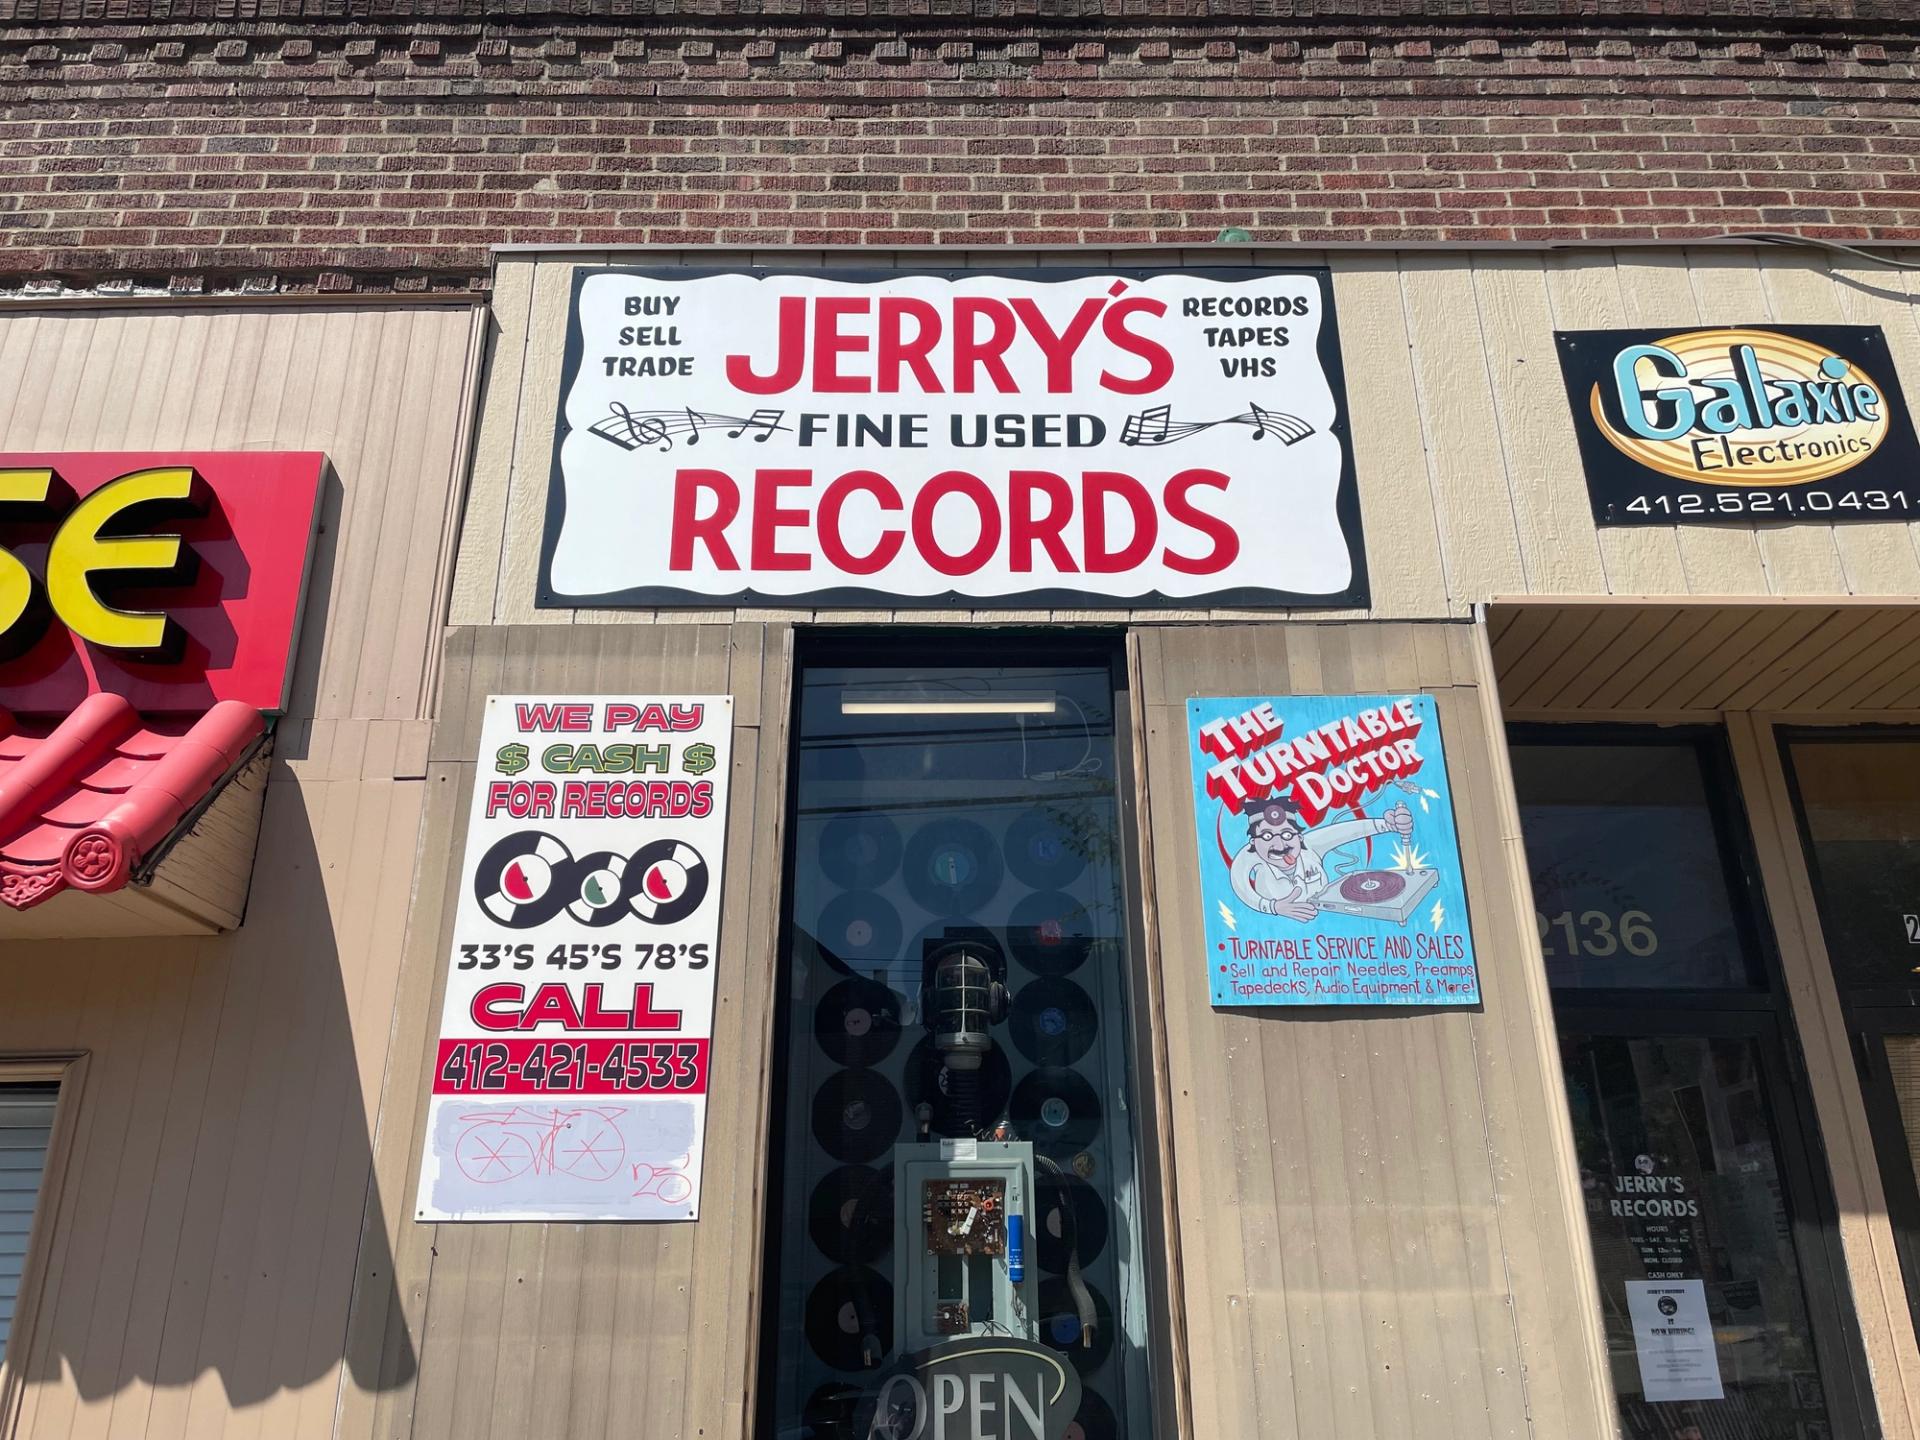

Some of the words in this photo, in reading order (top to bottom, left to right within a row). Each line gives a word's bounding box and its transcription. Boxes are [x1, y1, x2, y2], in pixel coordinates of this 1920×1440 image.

[624, 295, 680, 316] BUY
[1183, 295, 1310, 317] RECORDS
[618, 325, 682, 347] SELL
[725, 279, 1175, 396] JERRY'S
[1203, 326, 1290, 348] TAPES
[602, 355, 695, 377] TRADE
[1221, 357, 1278, 379] VHS
[1611, 343, 1880, 442] Galaxie
[798, 413, 929, 449] FINE
[951, 412, 1108, 449] USED
[1690, 434, 1873, 472] Electronics
[1625, 489, 1910, 516] 412.521.0431
[668, 467, 1241, 576] RECORDS
[515, 703, 594, 733] WE
[603, 703, 705, 733] PAY
[1200, 701, 1285, 757] THE
[495, 743, 530, 776] $
[541, 743, 671, 774] CASH
[682, 743, 717, 776] $
[1207, 699, 1424, 801] TURNTABLE
[1295, 738, 1425, 812] DOCTOR
[485, 780, 557, 819] FOR
[560, 780, 714, 819] RECORDS
[457, 944, 535, 971] 33'S
[546, 944, 622, 971] 45'S
[634, 944, 710, 970] 78'S
[1227, 936, 1313, 960] TURNTABLE
[1315, 933, 1379, 960] SERVICE
[1384, 935, 1412, 960] AND
[1416, 932, 1465, 960] SALES
[1230, 962, 1255, 978] Sell
[1262, 962, 1288, 977] and
[1292, 961, 1341, 983] Repair
[1347, 960, 1411, 979] Needles,
[1414, 960, 1475, 981] Preamps,
[1314, 978, 1350, 995] Audio
[1352, 977, 1421, 1000] Equipment
[1425, 978, 1434, 994] &
[470, 981, 683, 1031] CALL
[441, 1042, 699, 1090] 412-421-4533
[1615, 1175, 1685, 1194] JERRY'S
[1609, 1199, 1698, 1217] RECORDS
[1647, 1271, 1666, 1279] CASH
[873, 1371, 1046, 1440] OPEN
